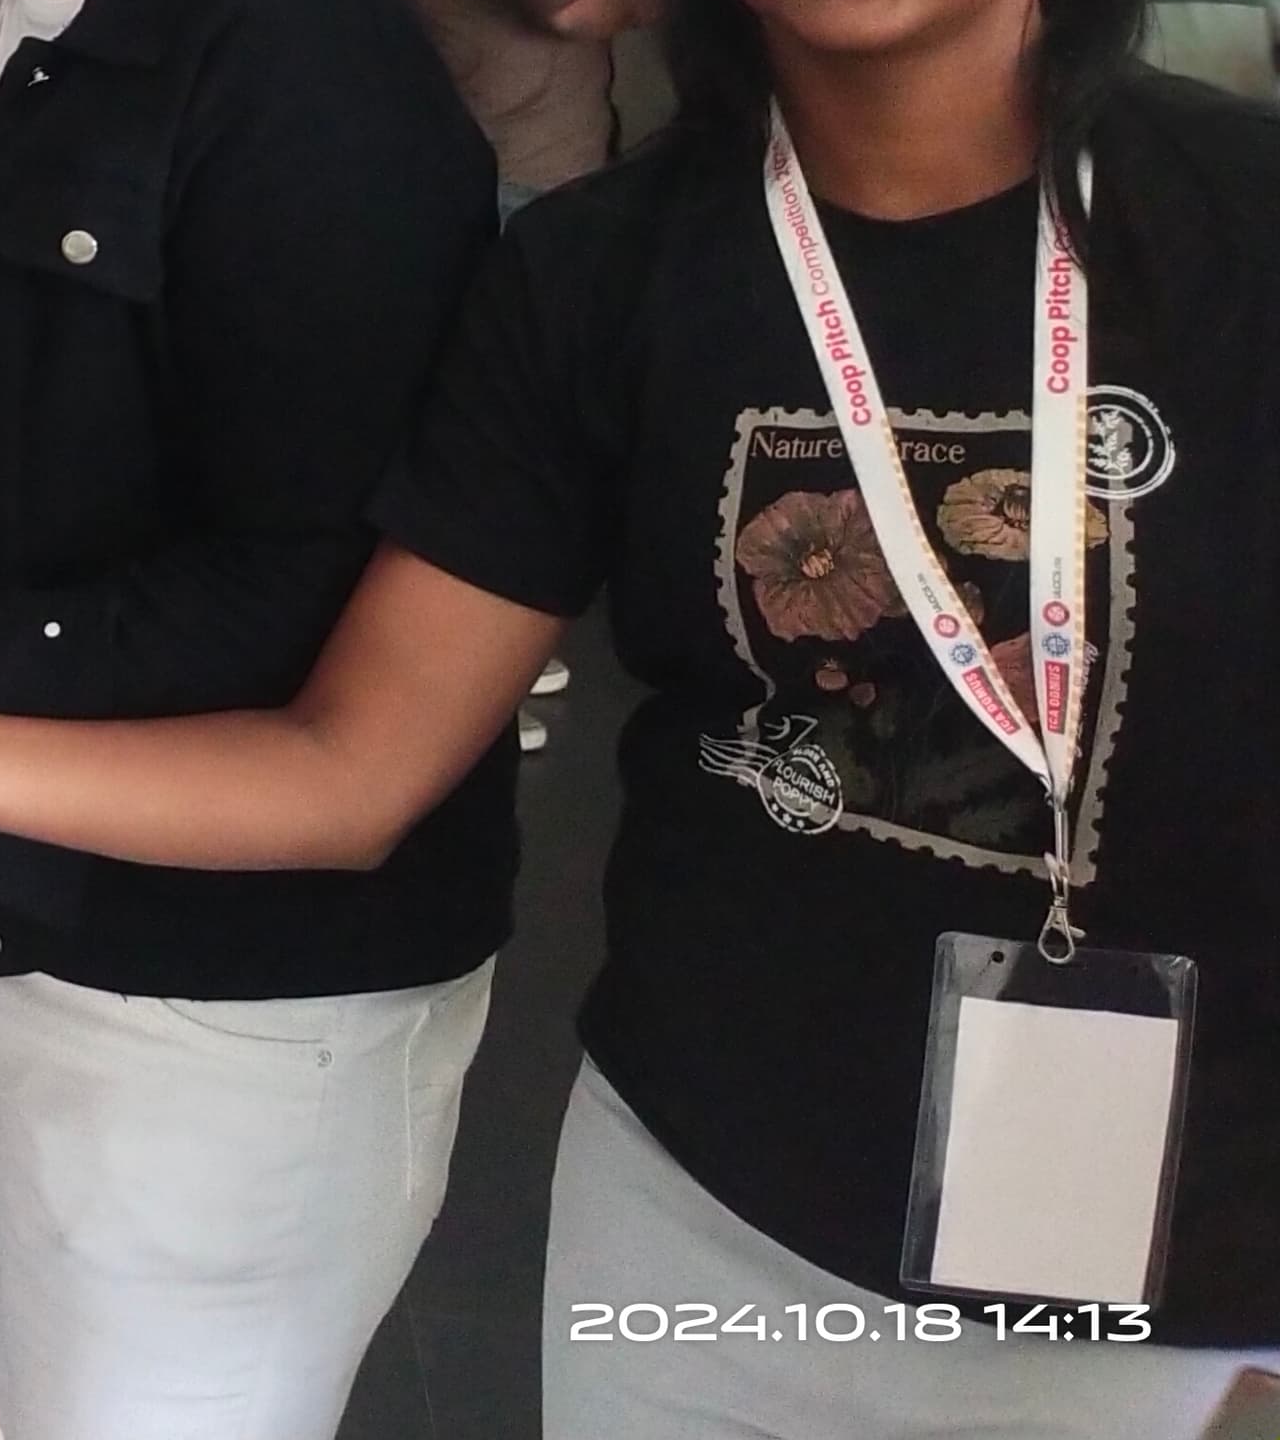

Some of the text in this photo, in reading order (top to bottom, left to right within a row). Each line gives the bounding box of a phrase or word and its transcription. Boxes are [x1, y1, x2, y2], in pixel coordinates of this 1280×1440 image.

[783, 180, 830, 297] Competition
[1045, 258, 1072, 321] Pitch
[817, 299, 853, 362] Pitch
[1047, 326, 1078, 394] Coop
[842, 362, 872, 427] Coop
[751, 431, 966, 464] Nature race
[966, 672, 1016, 732] ICA DOMUS
[773, 777, 819, 812] POPPY
